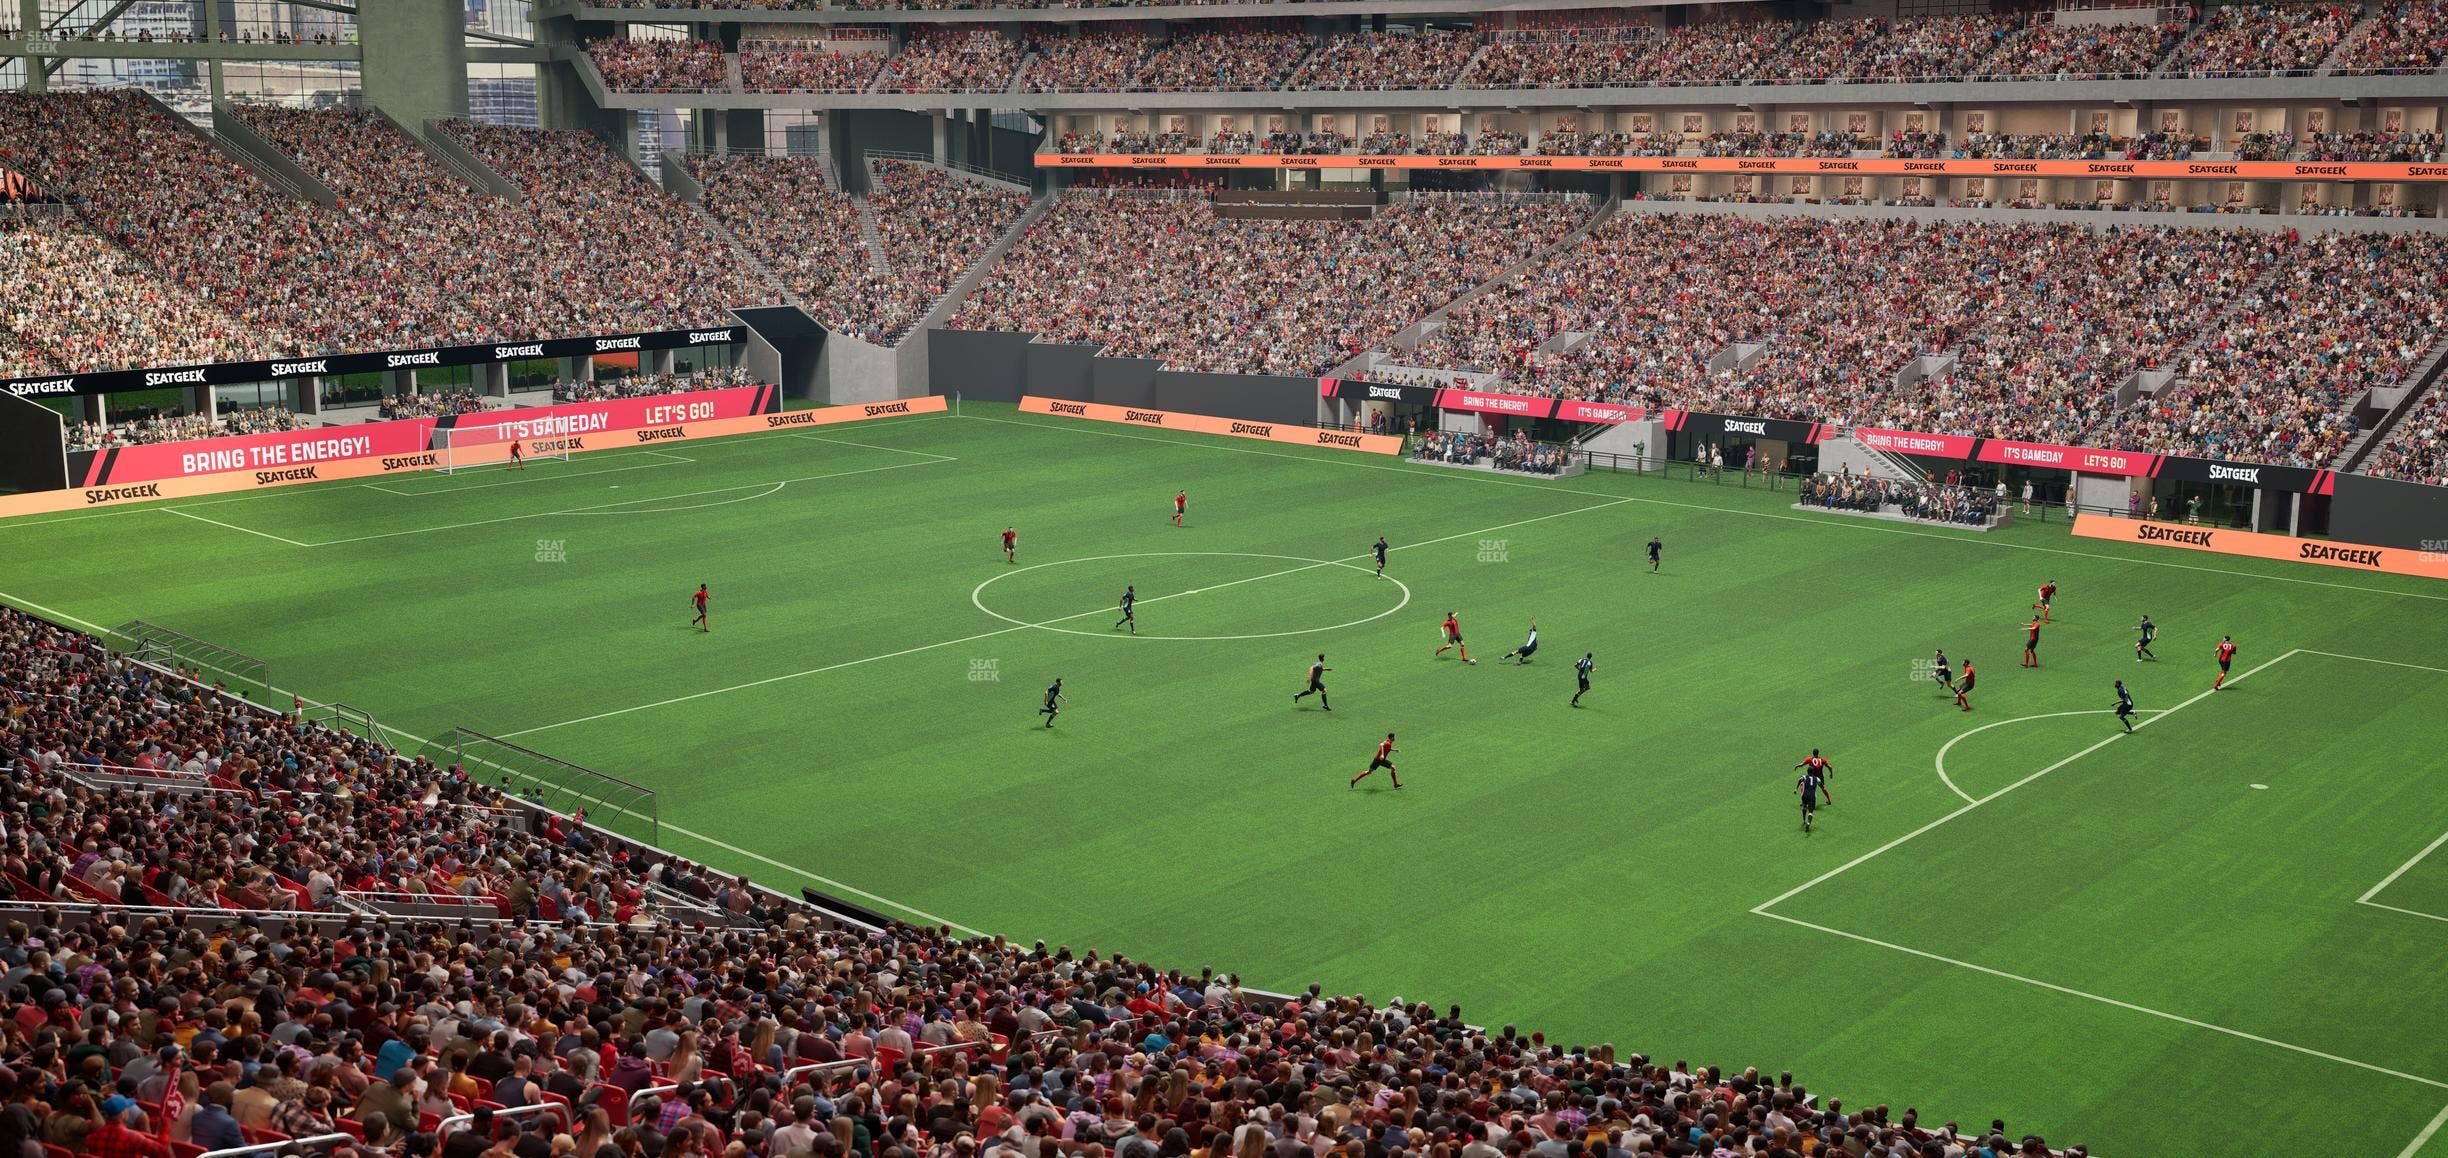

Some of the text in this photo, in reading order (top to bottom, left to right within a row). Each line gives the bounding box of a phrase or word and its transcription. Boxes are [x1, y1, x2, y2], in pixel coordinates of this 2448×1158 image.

[1206, 157, 1240, 165] SEATGEEK
[1281, 158, 1317, 166] SEATGEEK
[1359, 158, 1395, 166] SEATGEEK
[1439, 158, 1476, 166] SEATGEEK
[1662, 160, 1697, 168] SEATGEEK
[1739, 161, 1775, 169] SEATGEEK
[1819, 161, 1858, 170] SEATGEEK
[1904, 162, 1945, 171] SEATGEEK
[1994, 163, 2037, 172] SEATGEEK
[2089, 164, 2134, 173] SEATGEEK
[2189, 165, 2237, 174] SEATGEEK
[2295, 165, 2347, 175] SEATGEEK
[2408, 166, 2448, 176] SEATGE
[595, 336, 640, 351] SEATGEEK
[689, 330, 731, 344] SEATGEEK
[495, 343, 543, 359] SEATGEEK
[388, 352, 440, 367] SEATGEEK
[271, 359, 327, 377] SEATGEEK
[146, 368, 205, 386] SEATGEEK
[9, 378, 75, 396] SEATGEEK
[1369, 386, 1401, 400] SEATGEEK
[865, 401, 909, 416] SEATGEEK
[1050, 402, 1086, 416] SEATGEEK
[1463, 396, 1528, 411] BRING THE ENERGY!
[646, 401, 715, 424] LET'S GO!
[1125, 410, 1163, 425] SEATGEEK
[1578, 407, 1591, 417] IT'S
[498, 413, 608, 439] IT'S GAMEDAY
[768, 412, 816, 428] SEATGEEK
[1724, 419, 1765, 436] SEATGEEK
[637, 426, 685, 442] SEATGEEK
[1230, 422, 1273, 438] SEATGEEK
[1318, 432, 1362, 448] SEATGEEK
[1867, 434, 1944, 452] BRING THE ENERGY!
[183, 436, 370, 473] BRING THE ENERGY!
[2004, 447, 2063, 463] IT'S GAMEDAY
[2084, 454, 2126, 469] LET'S GO!
[256, 466, 318, 485] SEATGEEK
[2209, 464, 2260, 483] SEATGEEK
[86, 483, 161, 504] SEATGEEK
[2138, 524, 2213, 547] SEATGEEK
[2300, 543, 2382, 567] SEATGEEK
